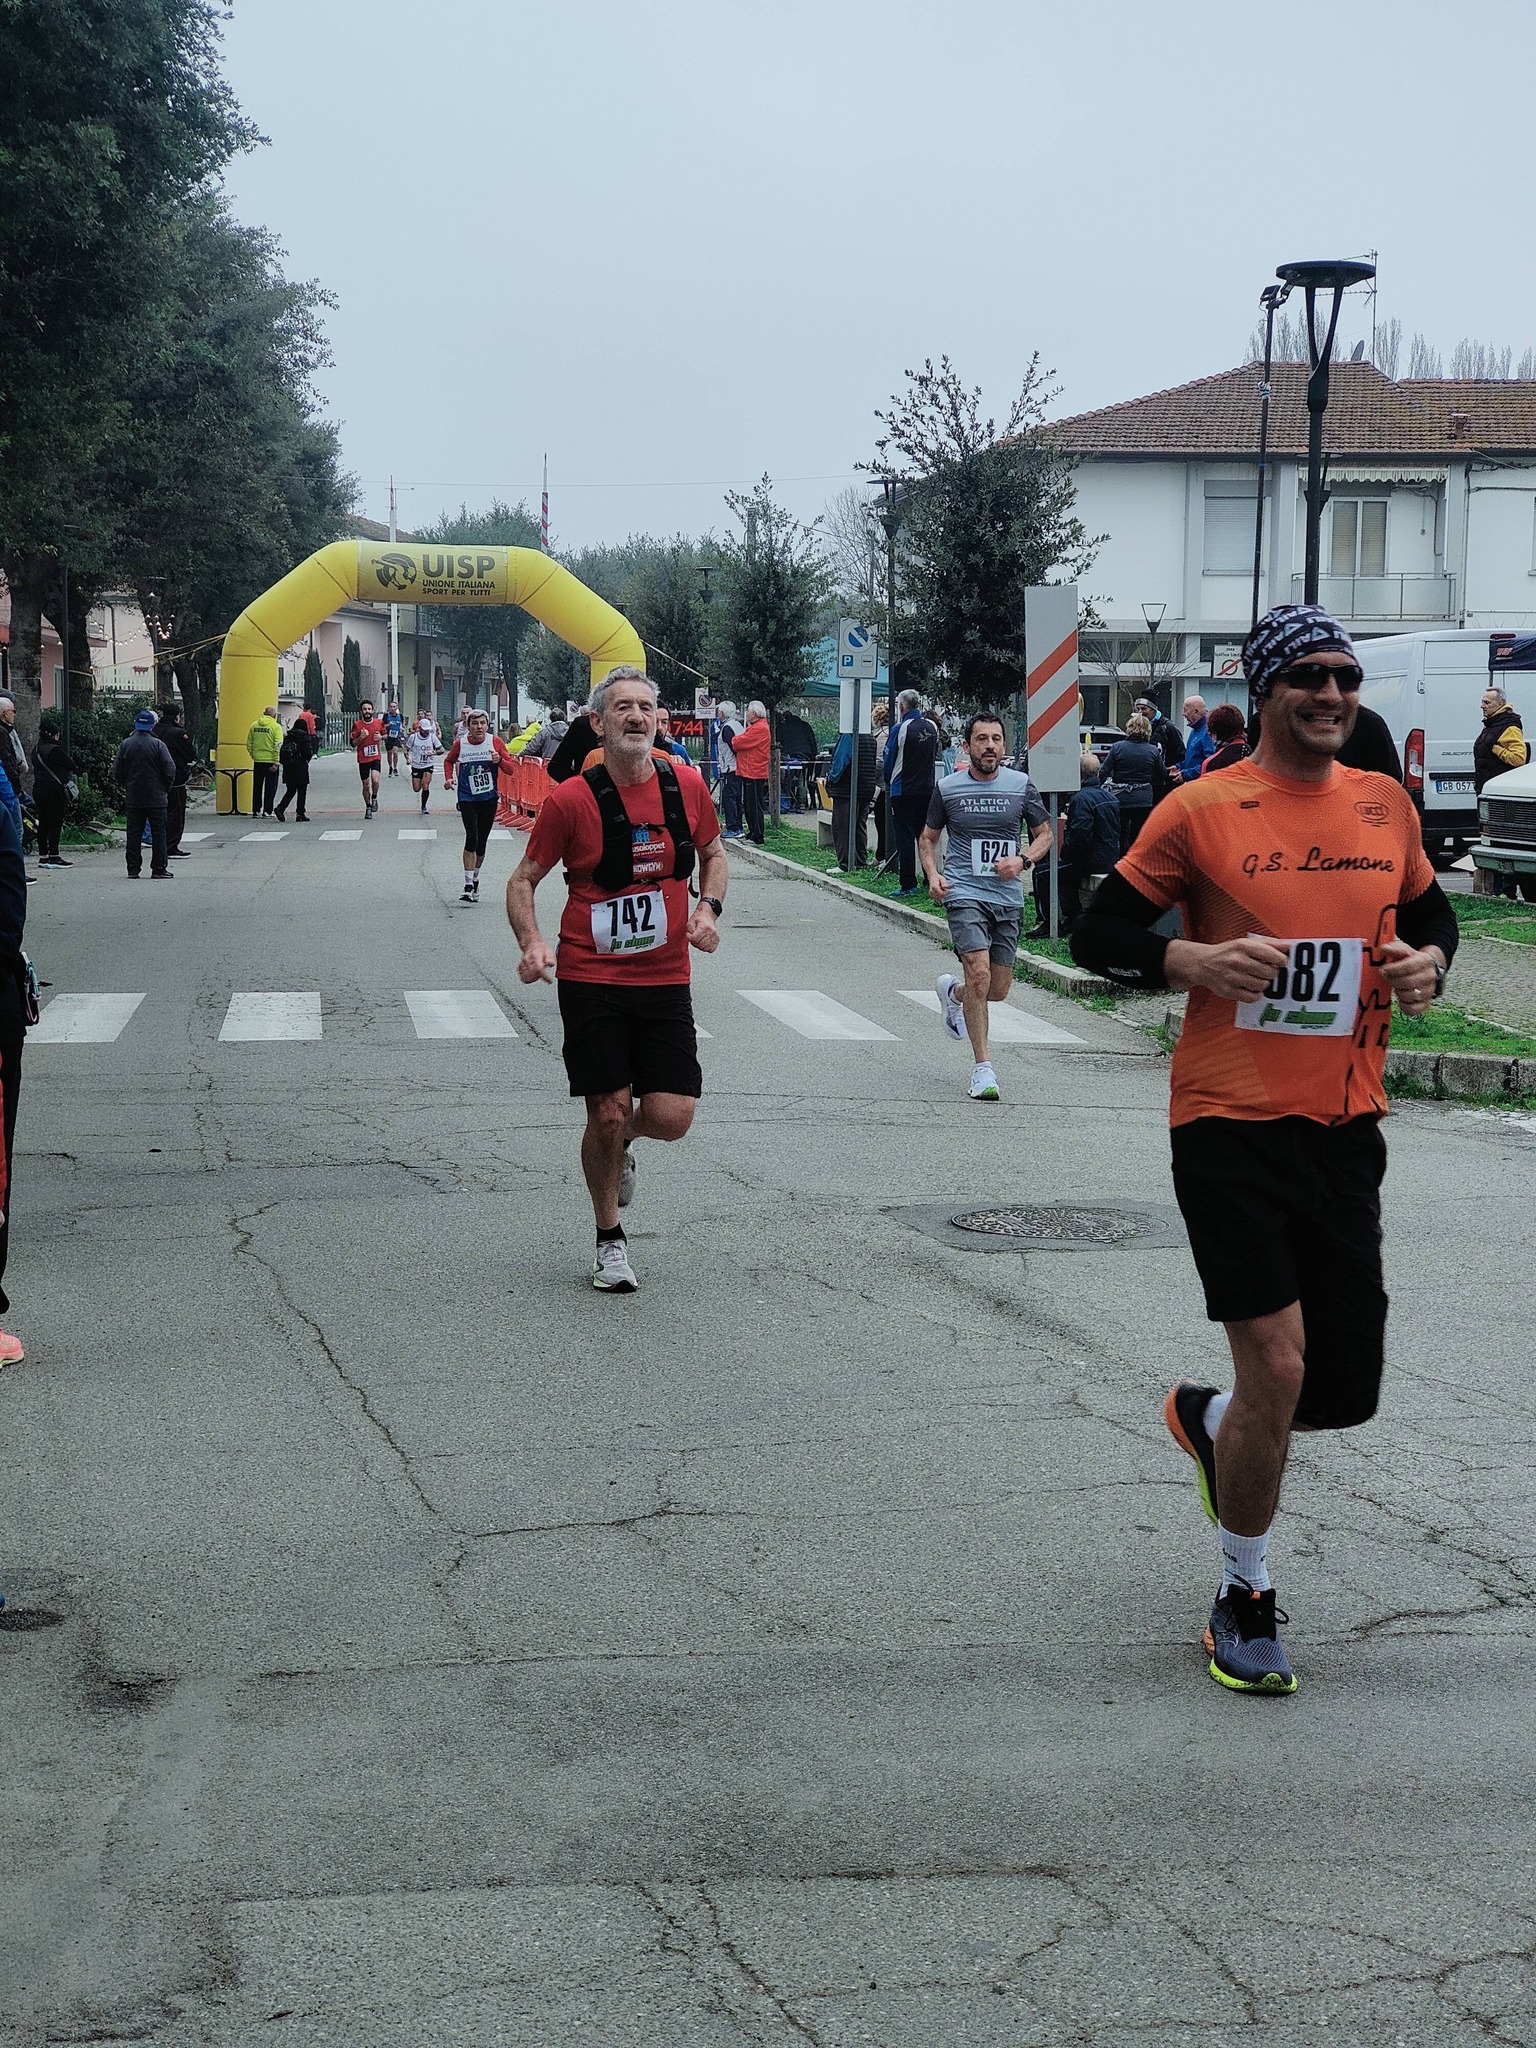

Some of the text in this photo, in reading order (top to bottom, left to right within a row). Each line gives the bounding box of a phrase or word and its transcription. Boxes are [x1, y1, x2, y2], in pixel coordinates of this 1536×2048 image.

[422, 553, 496, 579] UISP
[422, 579, 496, 589] UNIONE ITALIANA
[422, 587, 449, 596] SPORT
[451, 588, 466, 596] PER
[843, 656, 852, 666] P
[473, 773, 490, 788] 639
[959, 798, 1011, 806] ATLETICA
[980, 840, 1009, 864] 624
[1242, 846, 1396, 878] G.S. Lamone
[606, 894, 656, 937] 742
